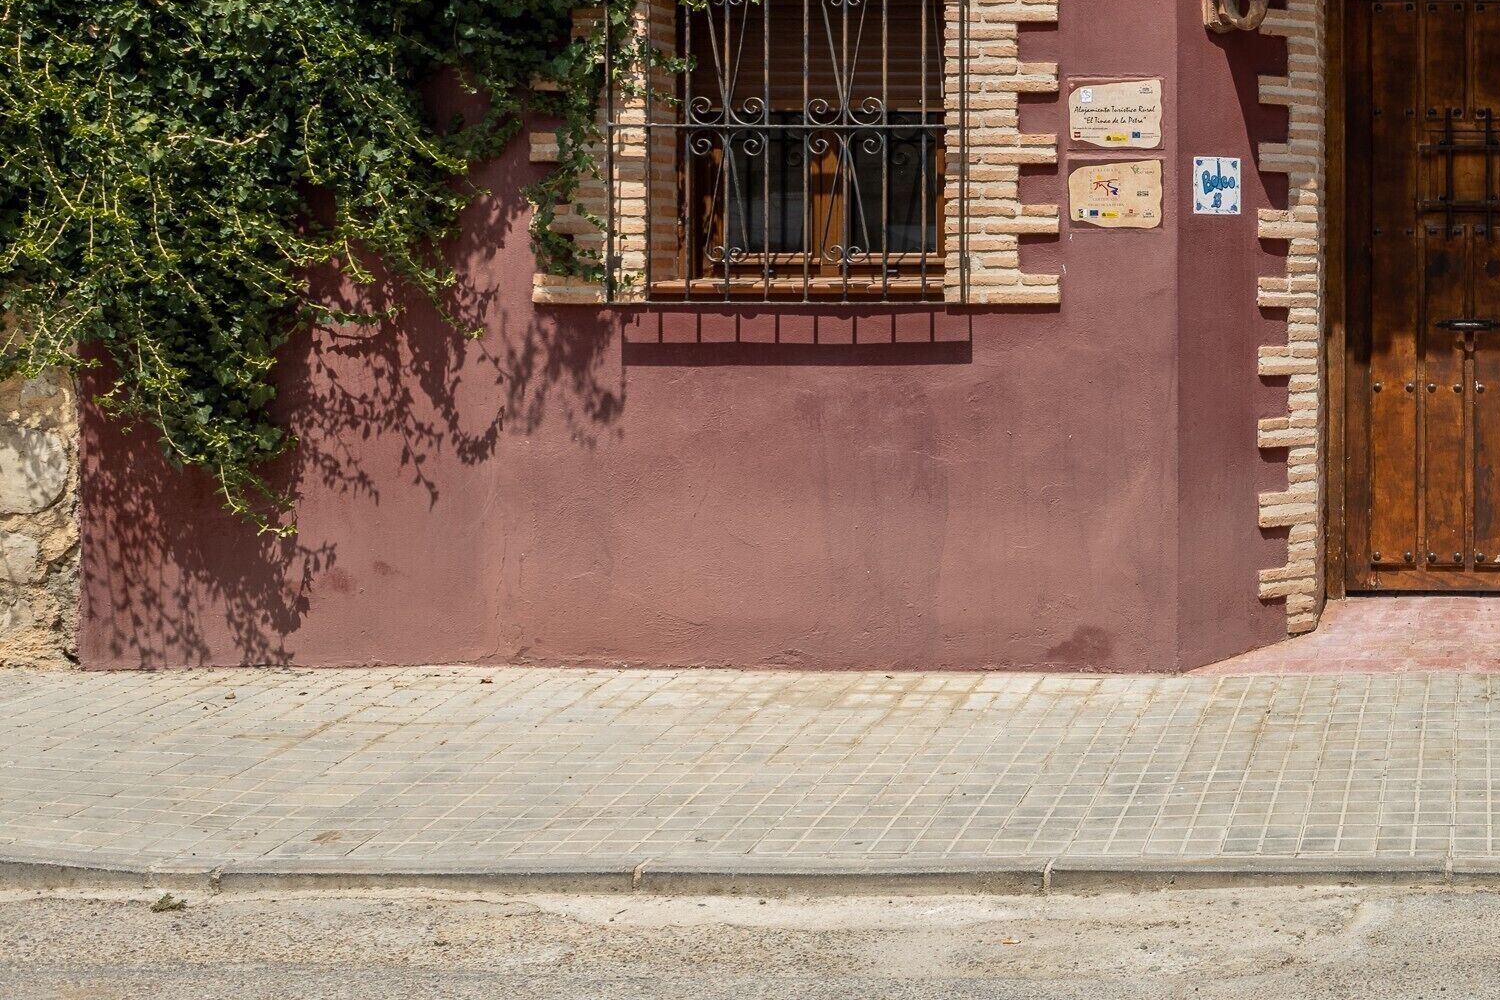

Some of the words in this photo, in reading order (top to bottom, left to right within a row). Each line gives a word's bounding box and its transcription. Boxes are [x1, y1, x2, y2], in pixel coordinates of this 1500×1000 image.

[1073, 105, 1110, 116] Alojamiento
[1138, 105, 1156, 113] Rural
[1111, 116, 1119, 124] de
[1119, 116, 1127, 124] la
